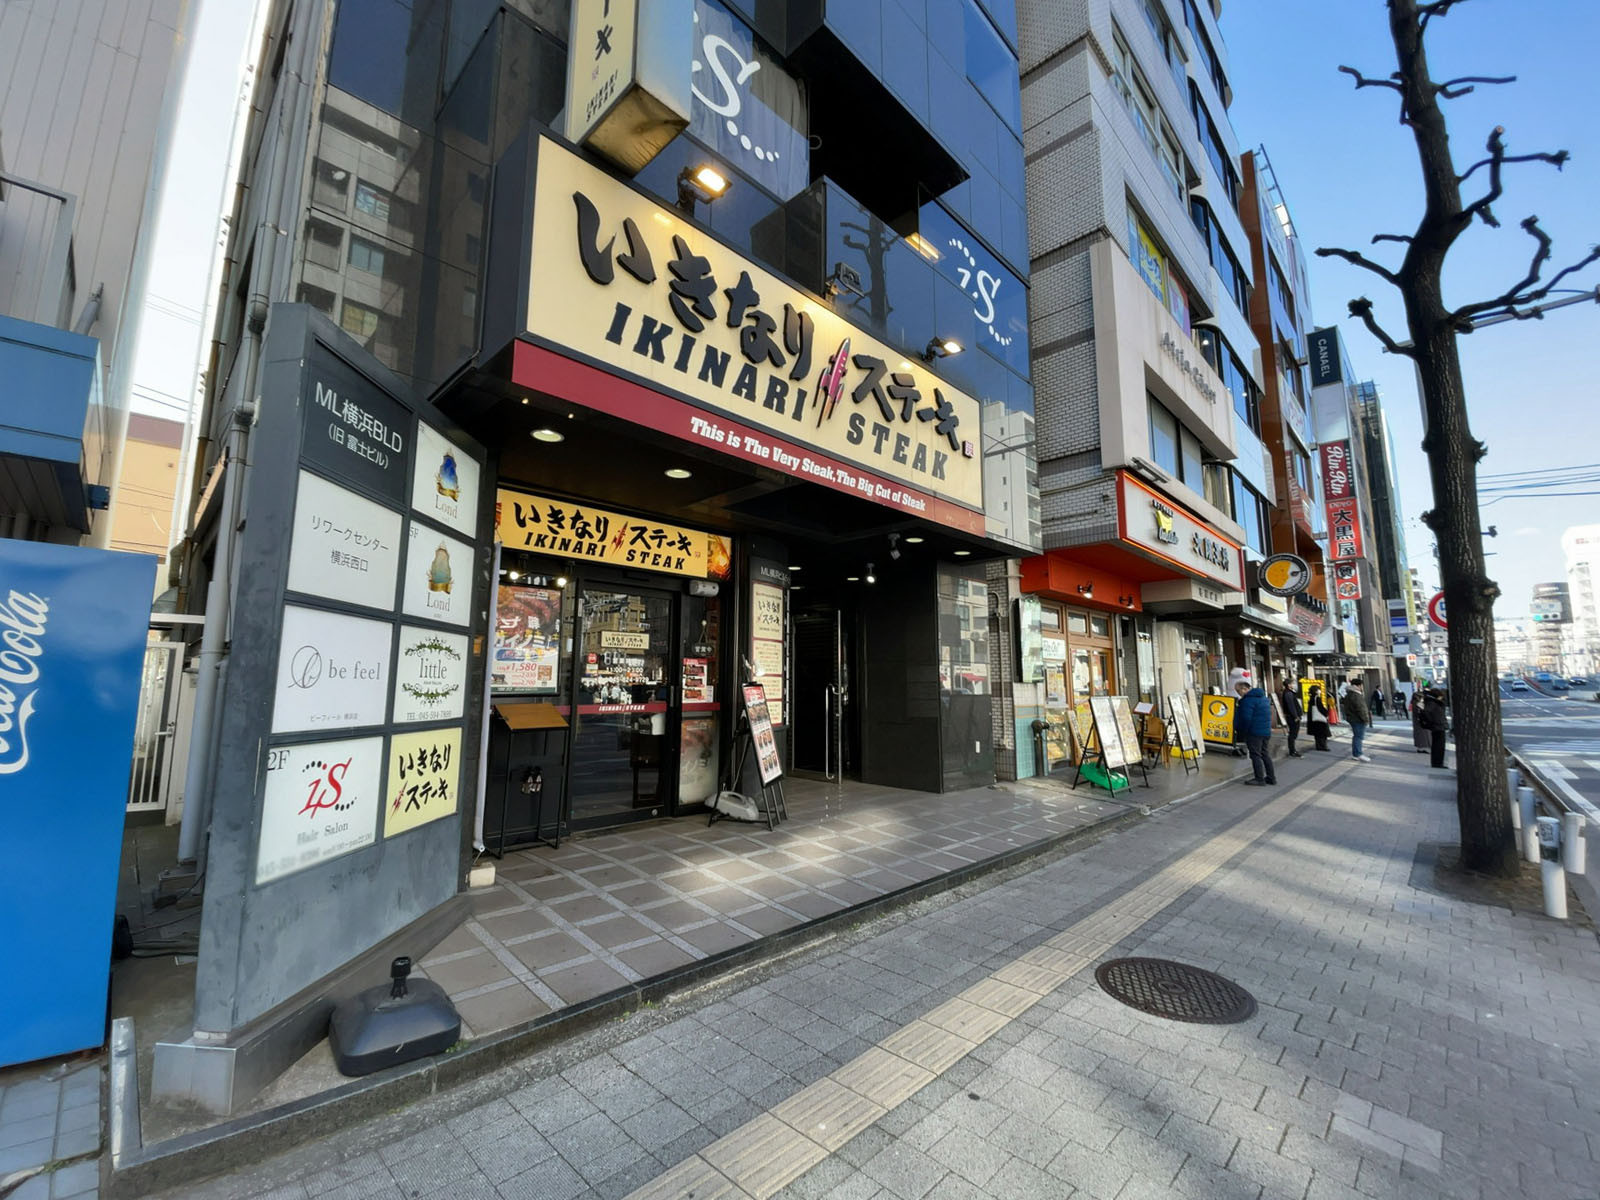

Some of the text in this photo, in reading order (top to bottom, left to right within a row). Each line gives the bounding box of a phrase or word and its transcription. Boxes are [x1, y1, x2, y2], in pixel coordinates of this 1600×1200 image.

[573, 191, 960, 451] いきなり ステーキ
[1318, 338, 1331, 378] CANAEL
[606, 301, 949, 481] IKINARI STEAK
[315, 381, 403, 453] ML横浜BLD
[691, 416, 725, 444] This
[726, 430, 740, 449] is
[744, 436, 770, 460] The
[772, 447, 800, 472] Very
[857, 479, 874, 497] Big
[875, 483, 892, 500] Cut
[892, 491, 902, 503] of
[902, 493, 926, 512] Steak
[312, 514, 389, 551] リワークセンター
[513, 502, 692, 556] いきなり ステーキ
[1332, 508, 1356, 558] 大黒屋
[331, 549, 369, 572] 横浜西口
[524, 531, 686, 570] IKINARI STEAK
[426, 591, 451, 613] Lond
[328, 659, 381, 681] be feel
[419, 658, 448, 680] little
[267, 750, 290, 772] 2F
[399, 743, 451, 780] いきなり
[405, 777, 449, 813] ステーキ
[325, 822, 349, 834] Salon
